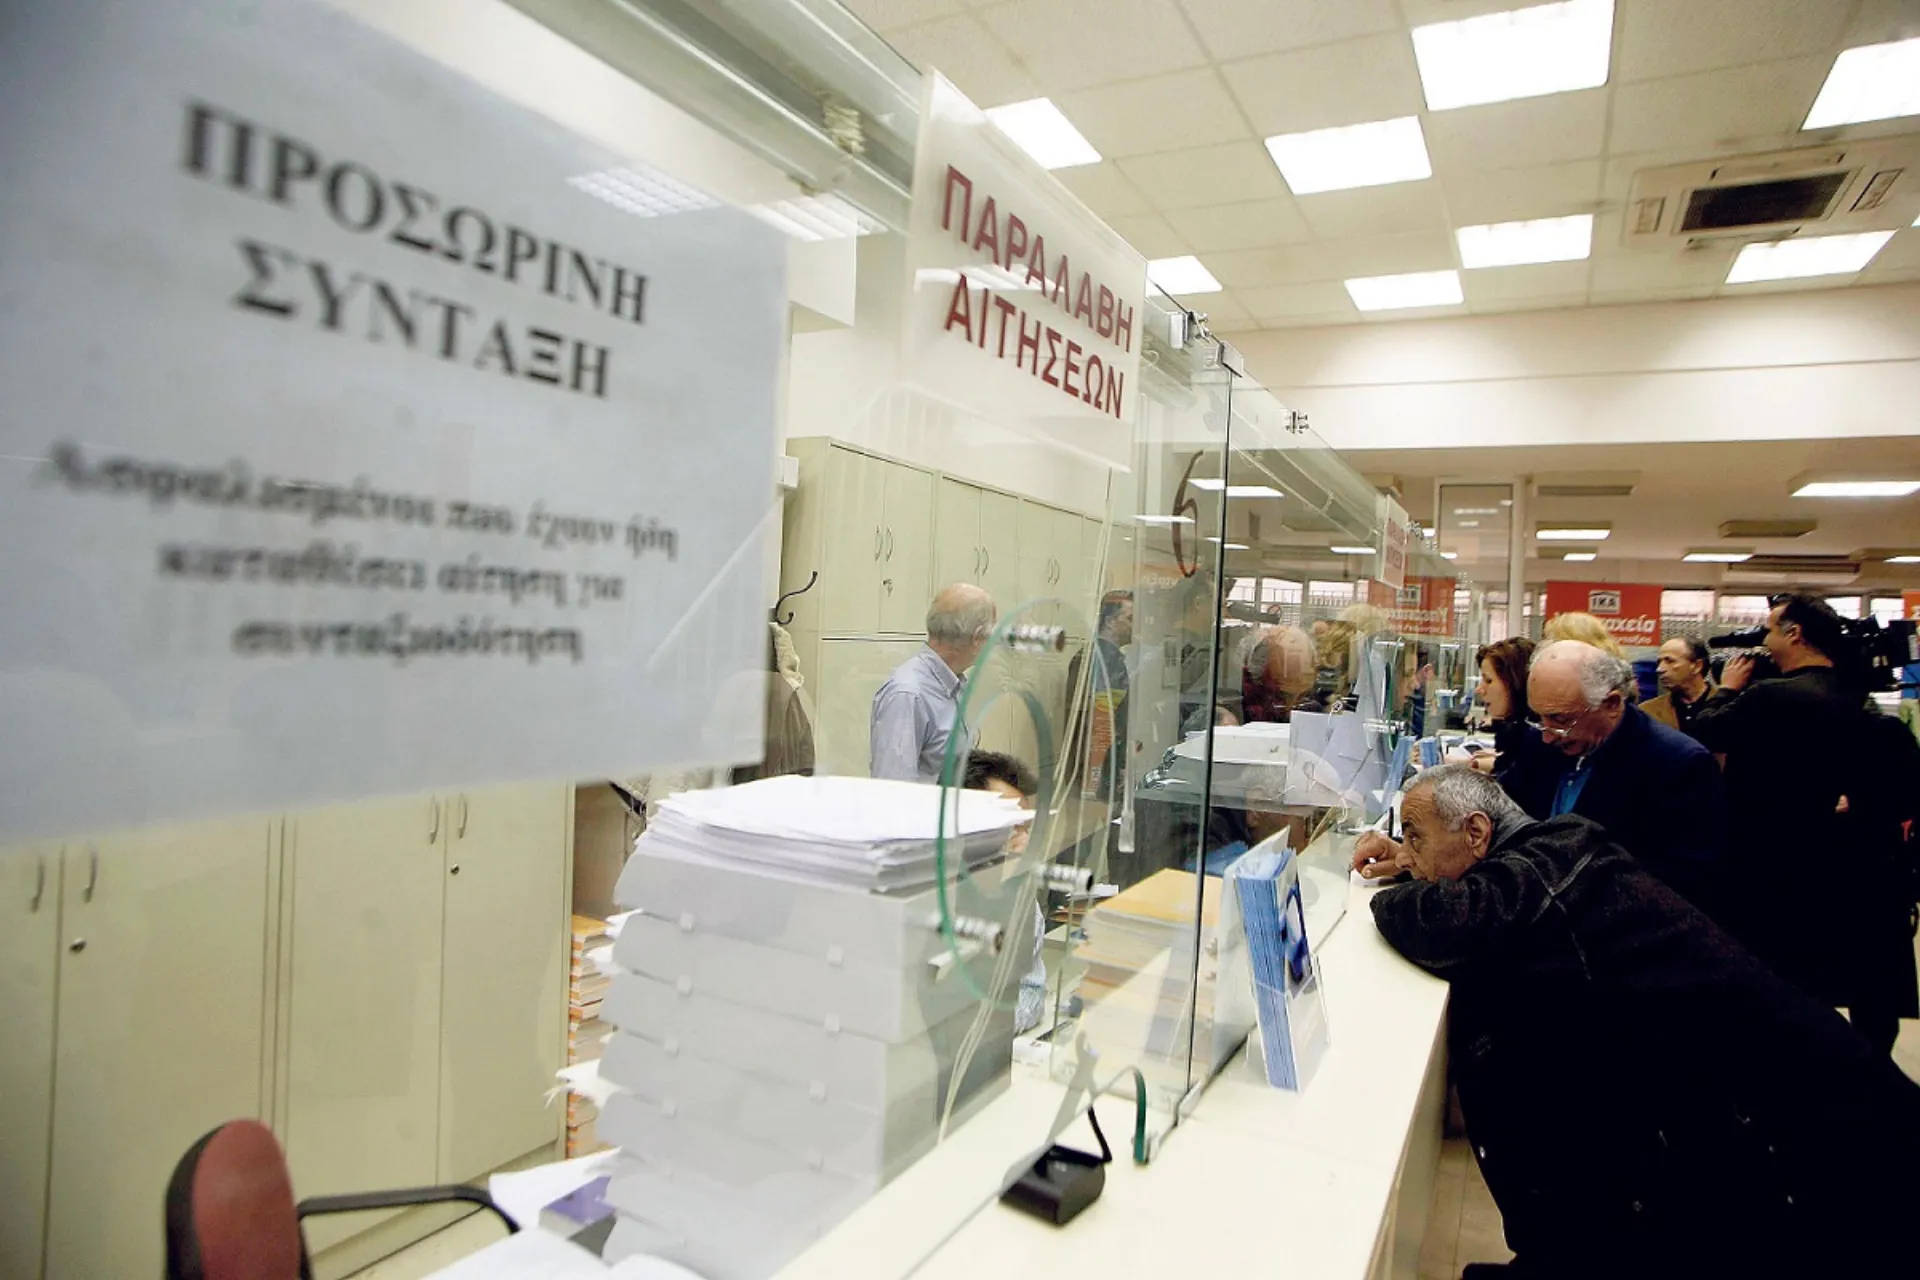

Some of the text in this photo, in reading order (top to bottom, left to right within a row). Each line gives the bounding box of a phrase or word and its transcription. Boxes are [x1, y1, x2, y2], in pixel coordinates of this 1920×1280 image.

[183, 103, 651, 324] ΠΡΟΣΩΡΙΝΗ
[941, 163, 1134, 353] ΠΑΡΑΛΑΒΗ
[233, 236, 611, 399] ΣΥΝΤΑΞΗ
[944, 272, 1124, 420] ΑΙΤΗΣΕΩΝ
[1172, 450, 1204, 578] 6
